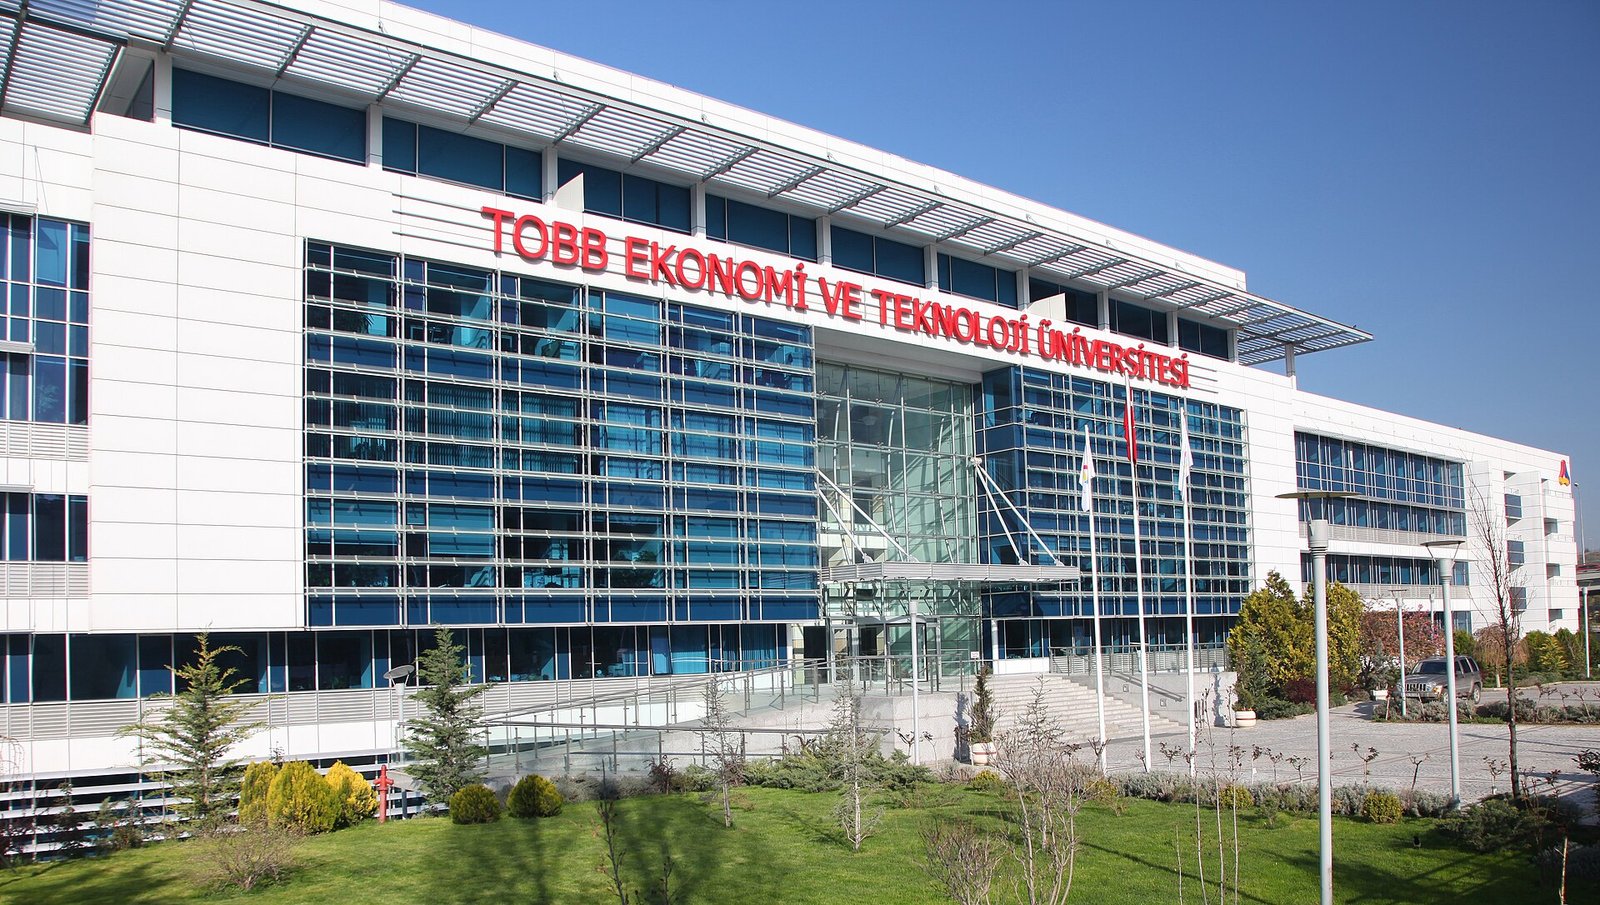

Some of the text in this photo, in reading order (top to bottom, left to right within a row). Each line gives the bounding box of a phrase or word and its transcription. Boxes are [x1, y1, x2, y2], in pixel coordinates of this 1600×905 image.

[481, 205, 1191, 388] TOBB EKONOMİ VE TEKNOLOJİ ÜNİVERSİTESİ
